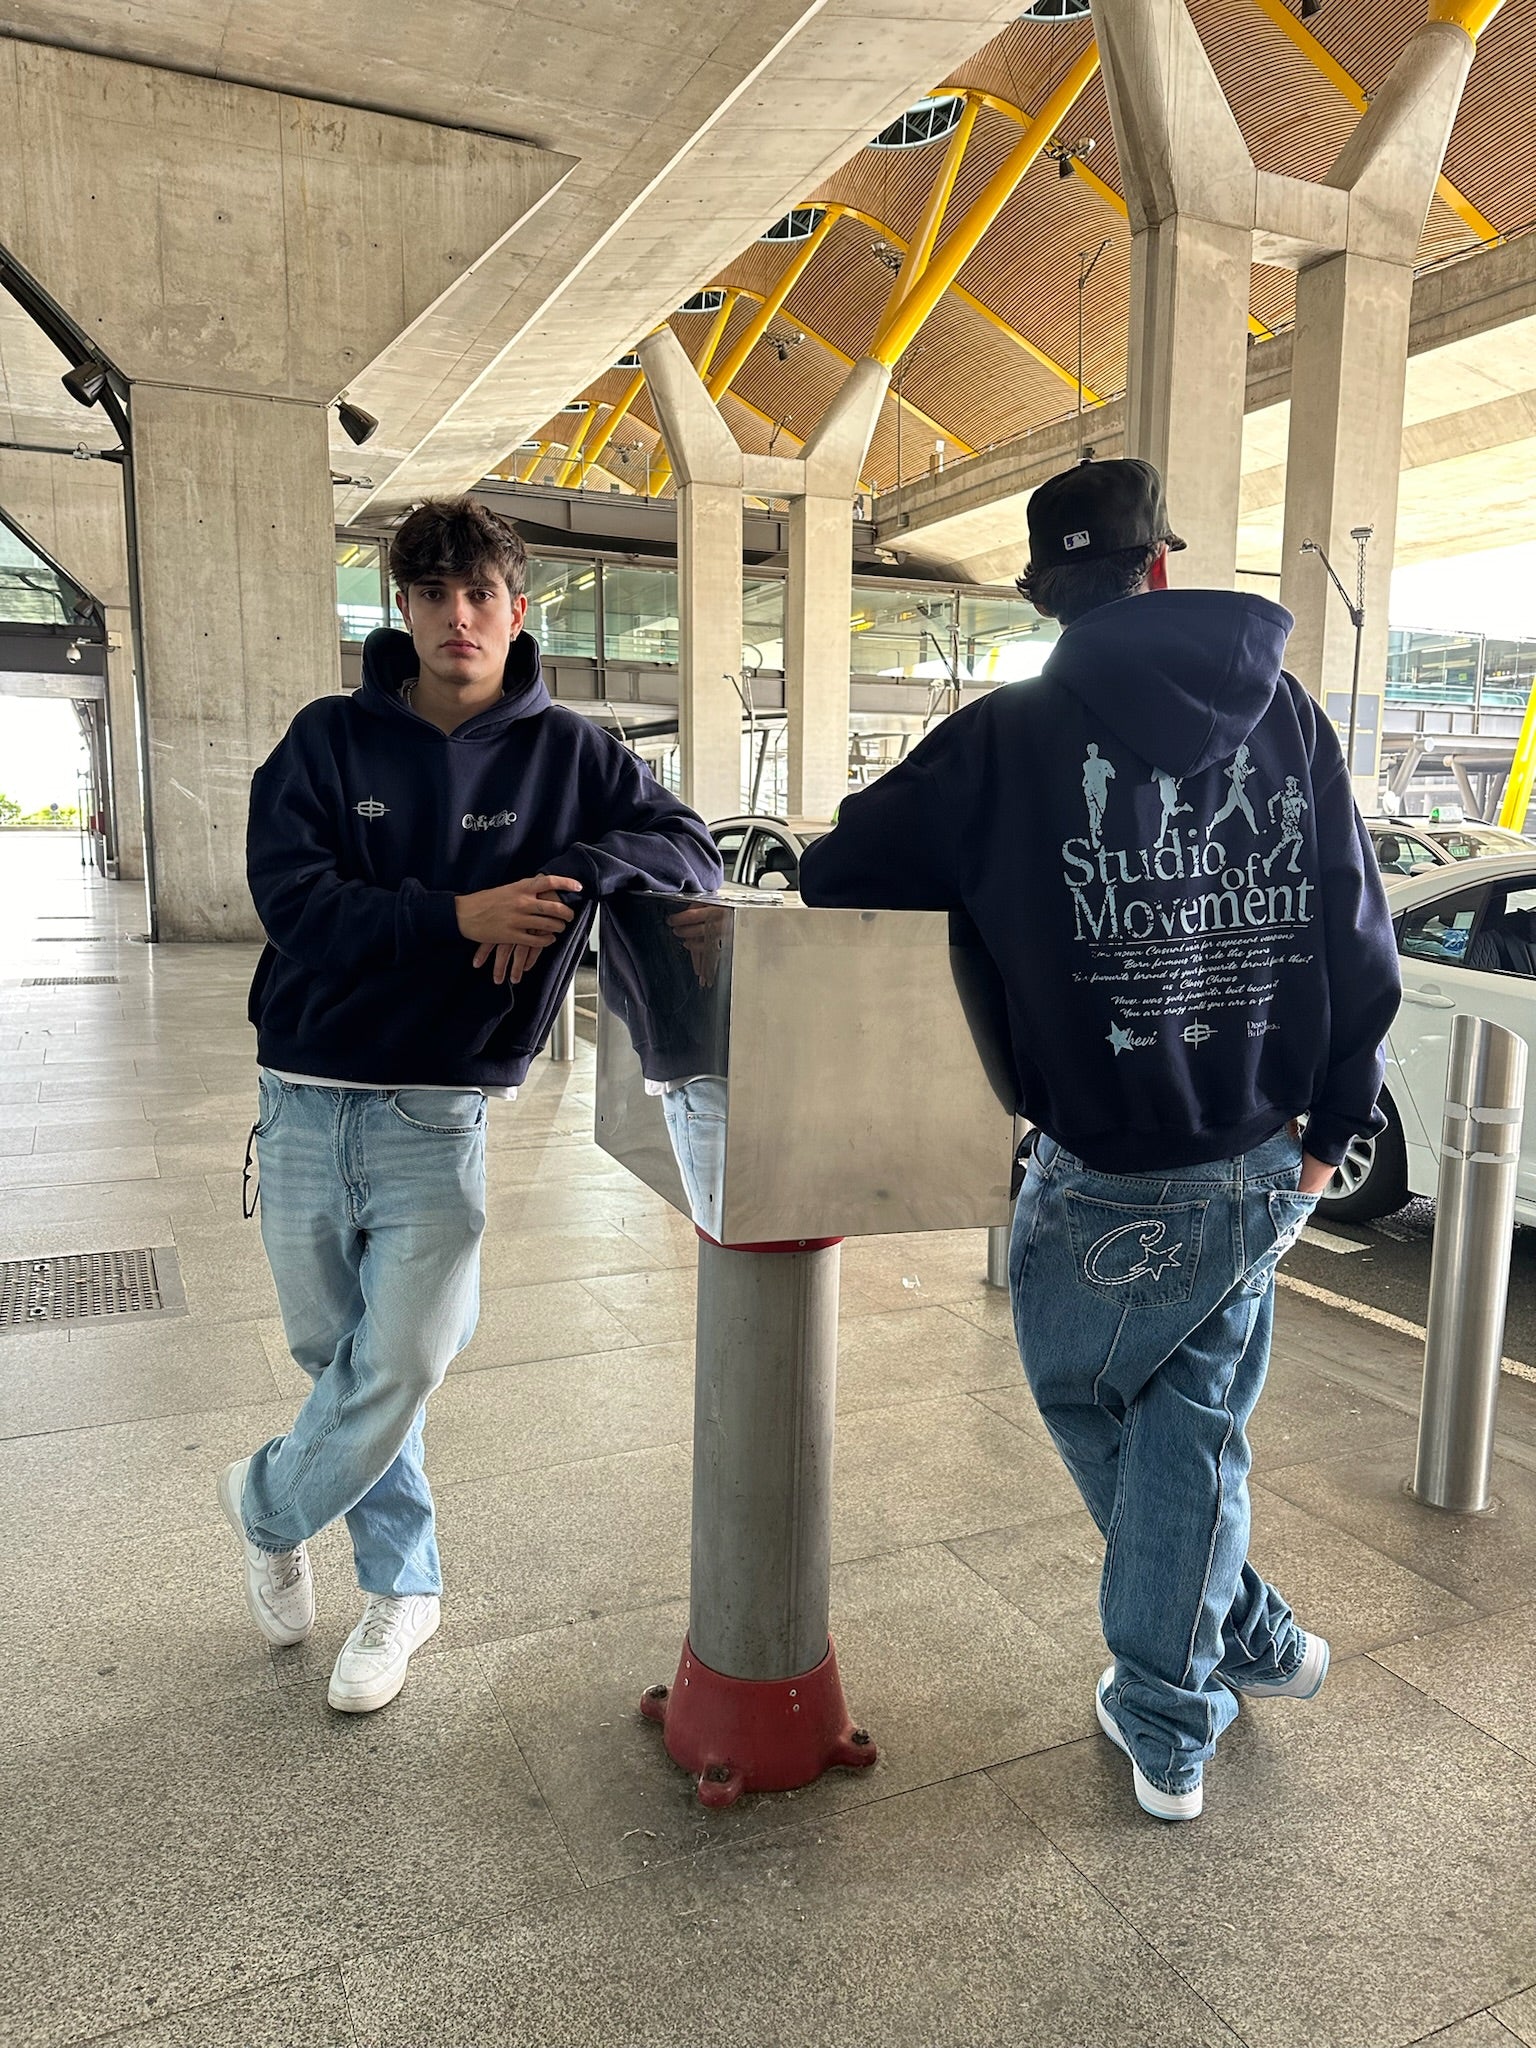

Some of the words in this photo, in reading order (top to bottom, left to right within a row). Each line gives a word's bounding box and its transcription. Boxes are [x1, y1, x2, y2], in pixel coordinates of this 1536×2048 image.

[1062, 827, 1227, 887] Studio
[1221, 852, 1261, 891] of
[1069, 876, 1315, 941] Movement
